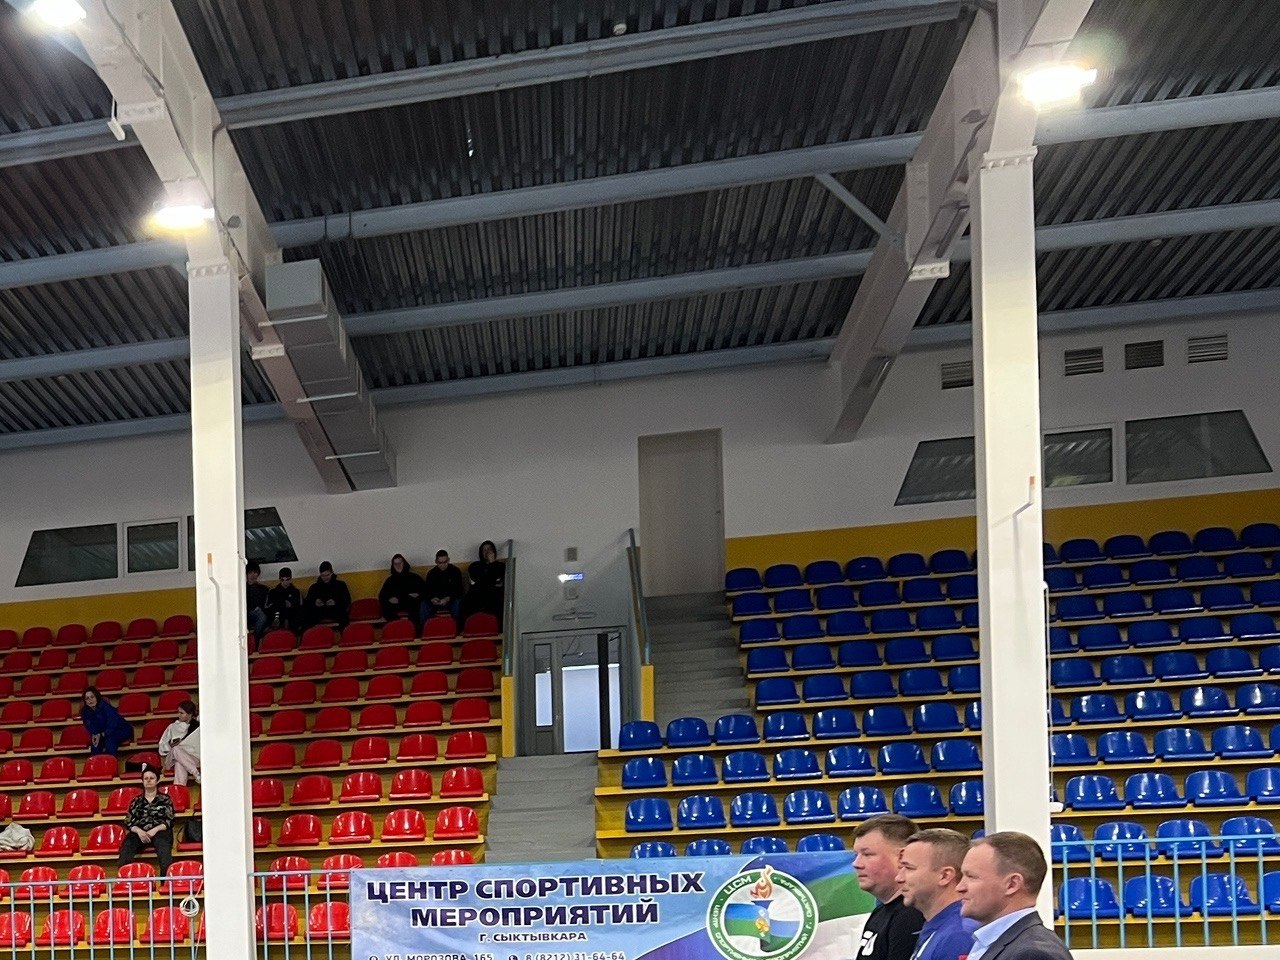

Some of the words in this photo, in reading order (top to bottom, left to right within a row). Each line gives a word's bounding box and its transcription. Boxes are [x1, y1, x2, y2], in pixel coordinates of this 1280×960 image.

[367, 881, 469, 903] ЦЕНТР
[475, 872, 705, 899] СПОРТИВНЫХ
[723, 875, 752, 895] ЦСМ
[411, 898, 659, 927] МЕРОПРИЯТИЙ
[493, 932, 587, 942] СЫКТЫВКАРА
